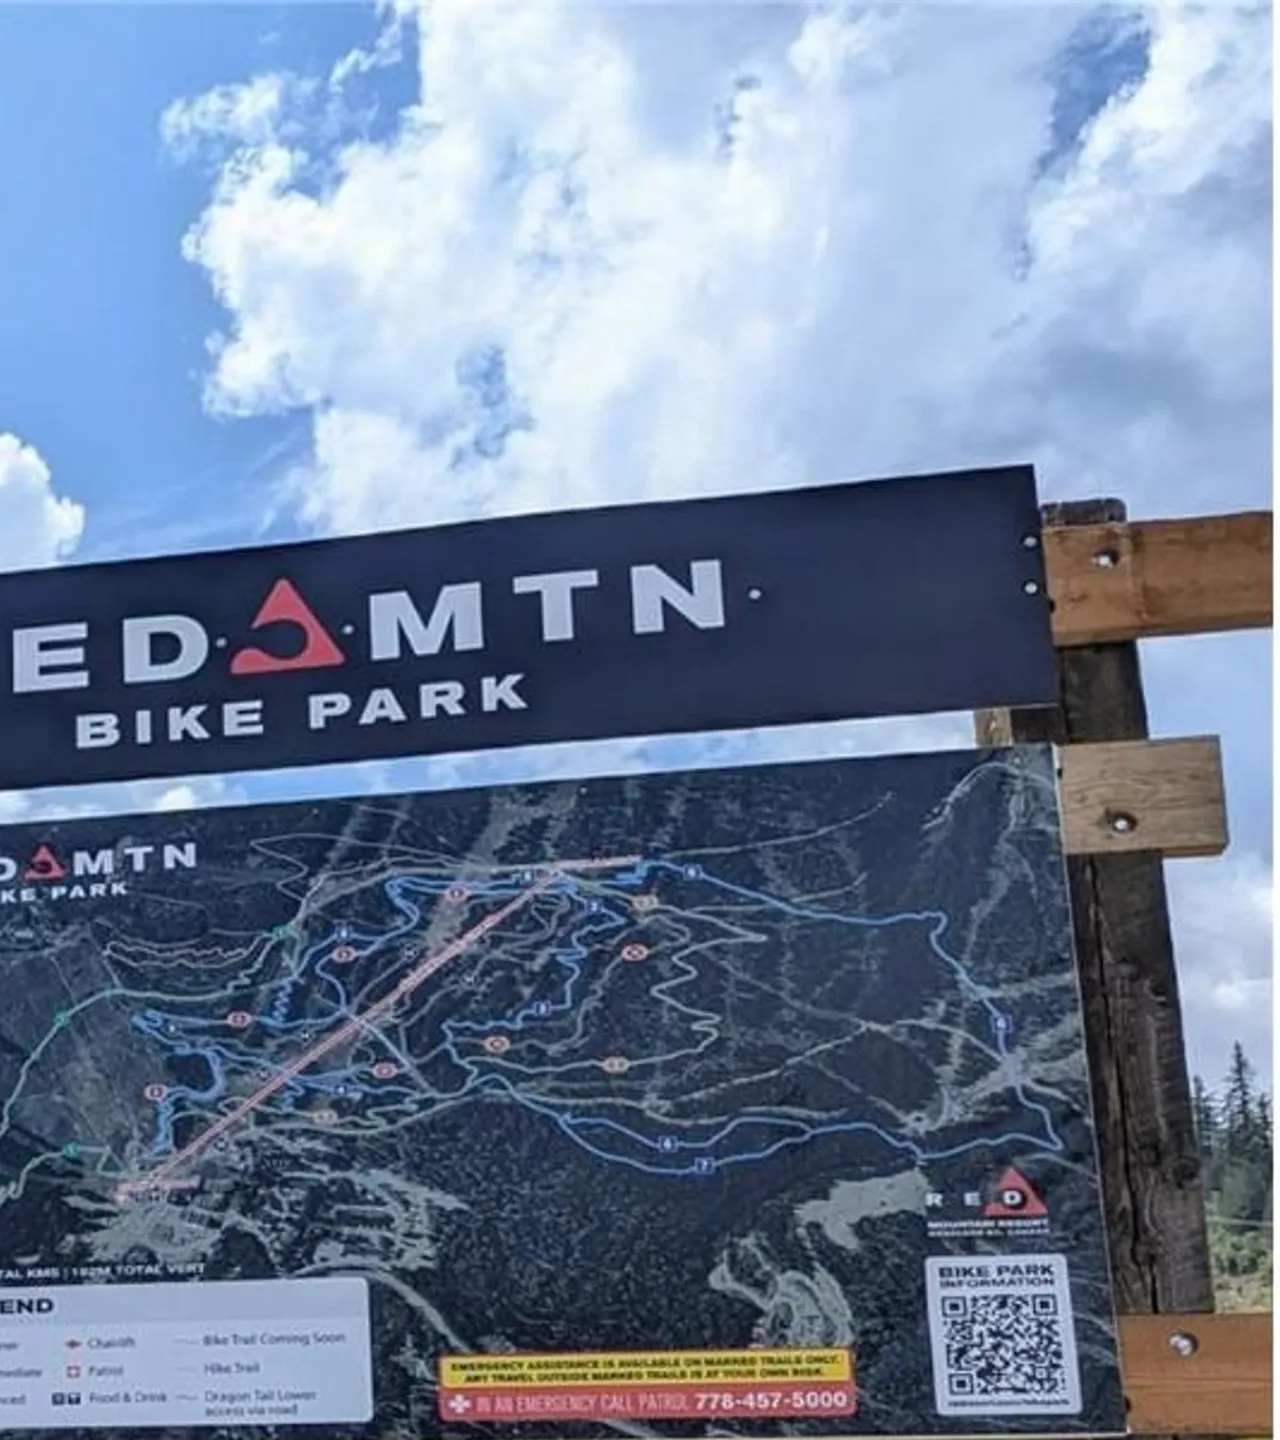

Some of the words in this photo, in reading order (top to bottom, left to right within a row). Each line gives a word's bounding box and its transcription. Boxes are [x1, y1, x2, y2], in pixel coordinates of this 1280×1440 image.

[369, 558, 727, 660] MTN
[74, 699, 263, 750] BIKE
[309, 672, 531, 731] PARK
[73, 843, 197, 876] MTN
[51, 881, 128, 900] PARK
[27, 1267, 60, 1279] KMS
[116, 1264, 162, 1276] TOTAL
[939, 1267, 990, 1278] BIKE
[997, 1264, 1054, 1276] PARK
[939, 1278, 1055, 1289] INFORMATION
[87, 1336, 136, 1349] Chairlift
[203, 1334, 228, 1346] Bike
[231, 1334, 257, 1345] Trail
[260, 1333, 309, 1347] Coming
[312, 1332, 345, 1344] Soon
[204, 1363, 231, 1374] Hike
[234, 1362, 259, 1373] Trail
[451, 1361, 523, 1371] EMERGENCY
[527, 1360, 598, 1370] ASSISTANCE
[603, 1359, 614, 1368] IS
[618, 1358, 680, 1368] AVAILABLE
[684, 1357, 701, 1367] ON
[704, 1356, 757, 1366] MARKED
[760, 1355, 802, 1365] TRAILS
[88, 1366, 124, 1378] Patrol
[492, 1373, 533, 1383] TRAVEL
[536, 1372, 588, 1382] OUTSIDE
[592, 1371, 644, 1381] MARKED
[647, 1370, 687, 1380] TRAILS
[721, 1368, 755, 1378] YOUR
[759, 1368, 789, 1377] OWN
[89, 1392, 120, 1404] Food
[134, 1391, 167, 1403] Drink
[205, 1390, 251, 1404] Dragon
[255, 1390, 274, 1401] Tail
[278, 1389, 316, 1401] Lower
[517, 1395, 598, 1412] EMERGENCY
[601, 1394, 635, 1412] CALL
[695, 1391, 848, 1411] 778-457-5000
[206, 1406, 244, 1417] access
[247, 1406, 266, 1416] via
[268, 1404, 297, 1415] road
